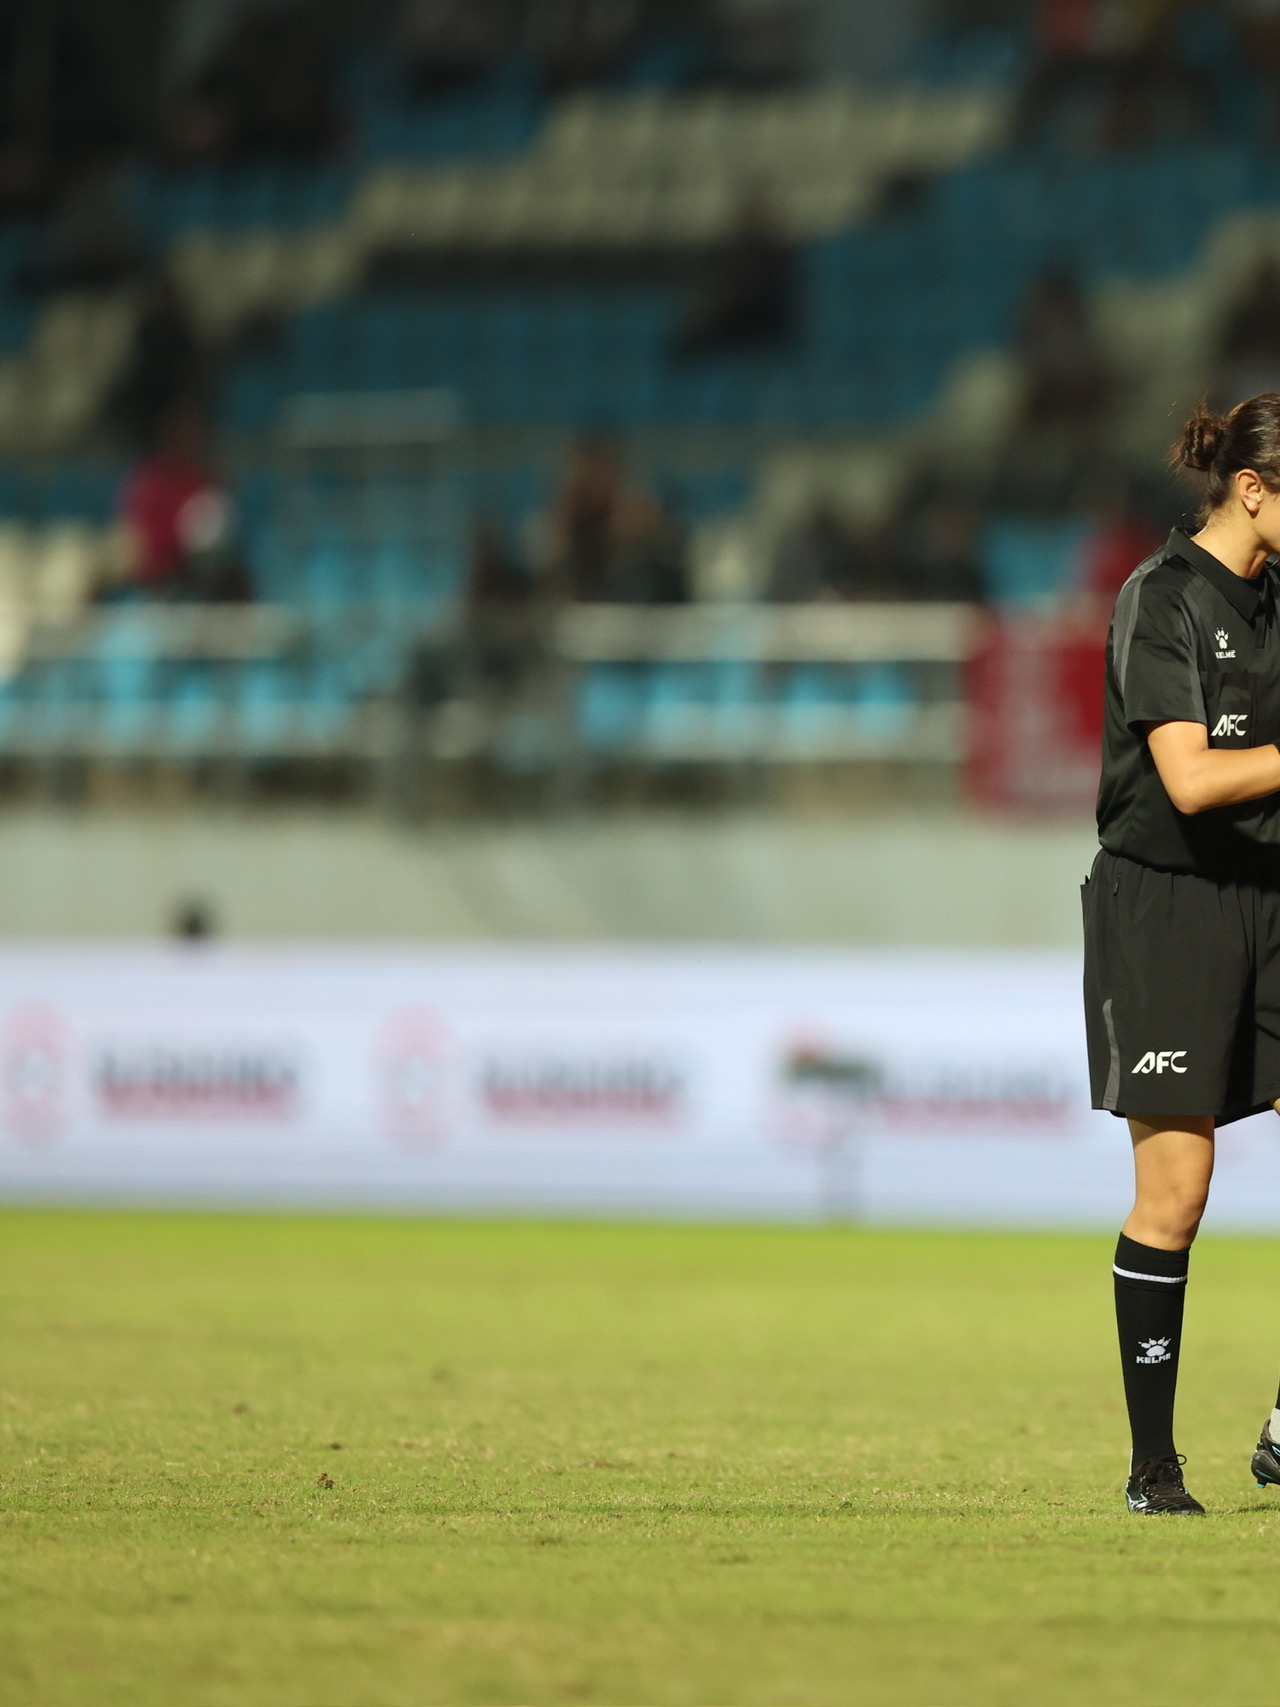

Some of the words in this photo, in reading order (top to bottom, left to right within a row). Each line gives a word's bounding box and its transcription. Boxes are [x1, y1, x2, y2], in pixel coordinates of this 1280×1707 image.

[1210, 714, 1249, 736] AFC
[1131, 1050, 1188, 1074] AFC
[1136, 1352, 1171, 1364] KELME
